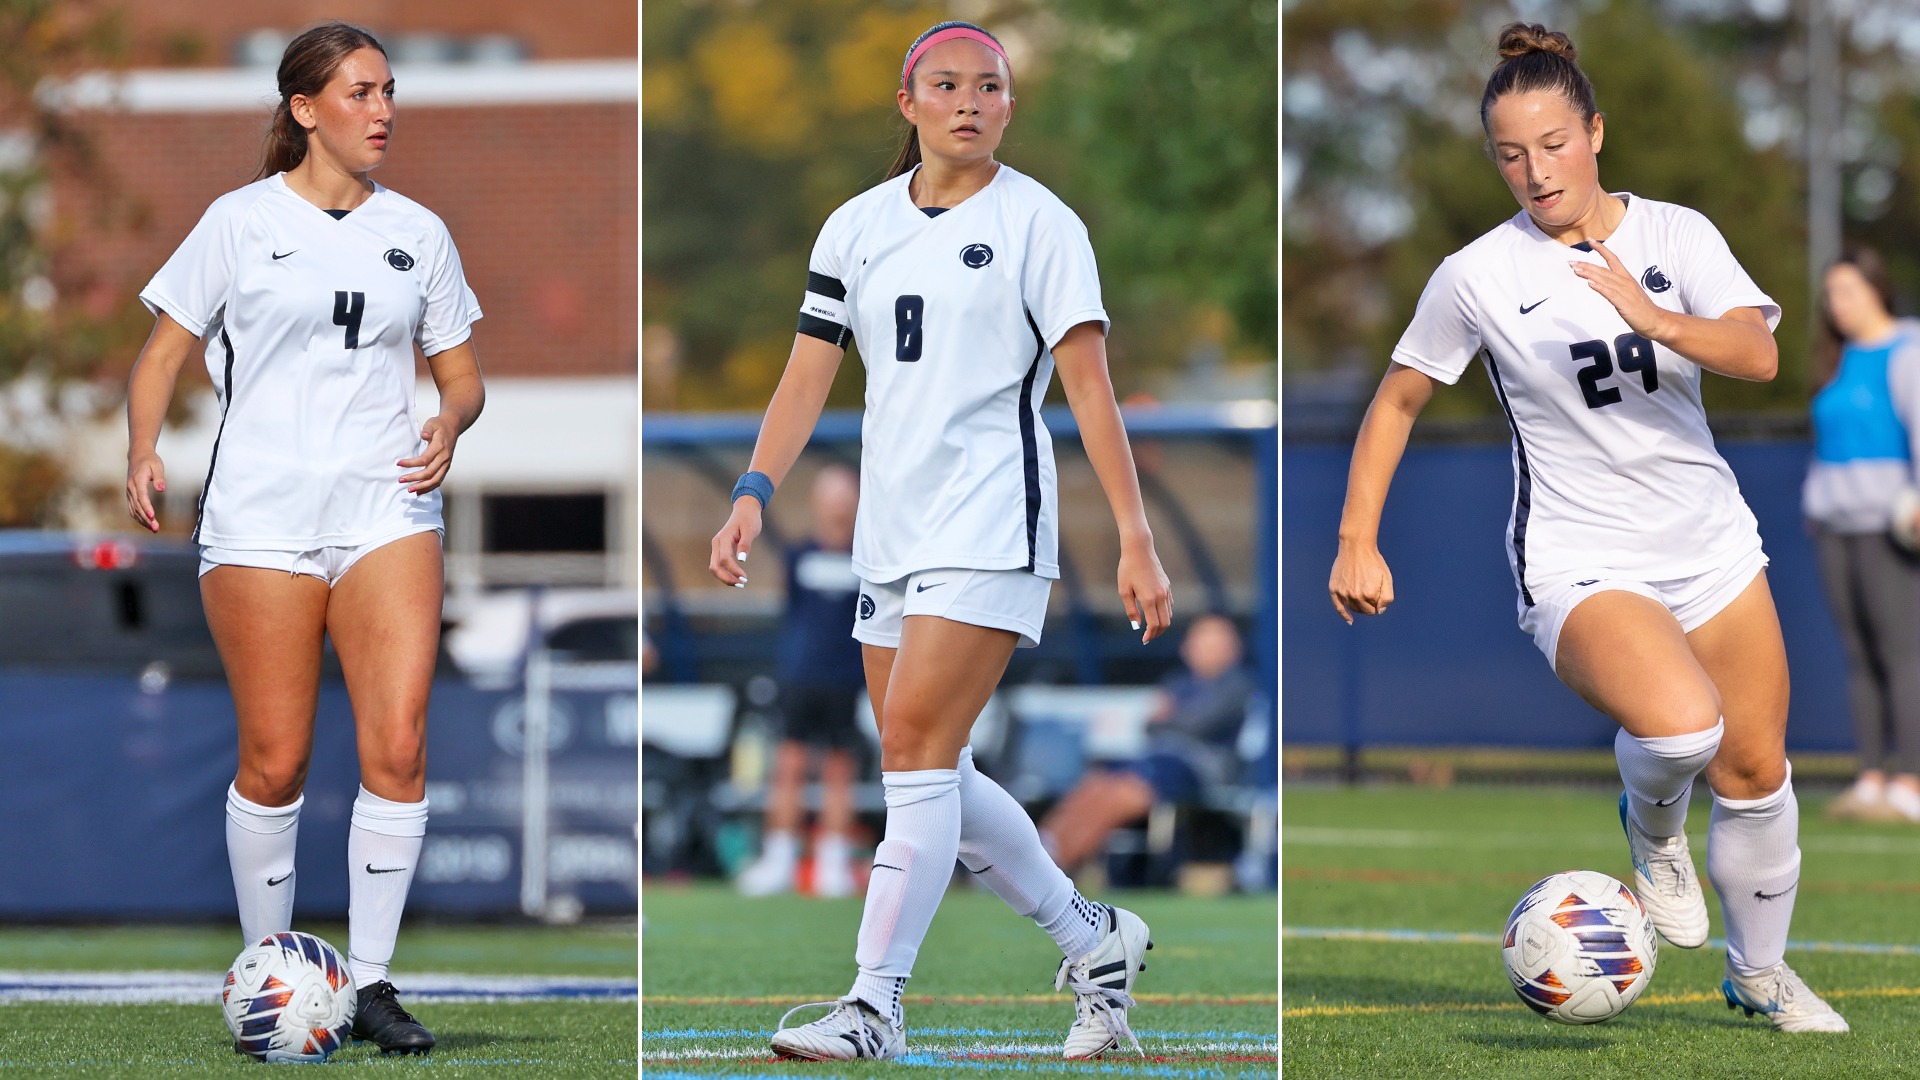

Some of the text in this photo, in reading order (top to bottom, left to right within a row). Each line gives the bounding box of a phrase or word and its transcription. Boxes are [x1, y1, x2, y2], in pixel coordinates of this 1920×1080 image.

[332, 291, 366, 350] 4
[895, 295, 924, 362] 8
[1569, 331, 1659, 410] 29
